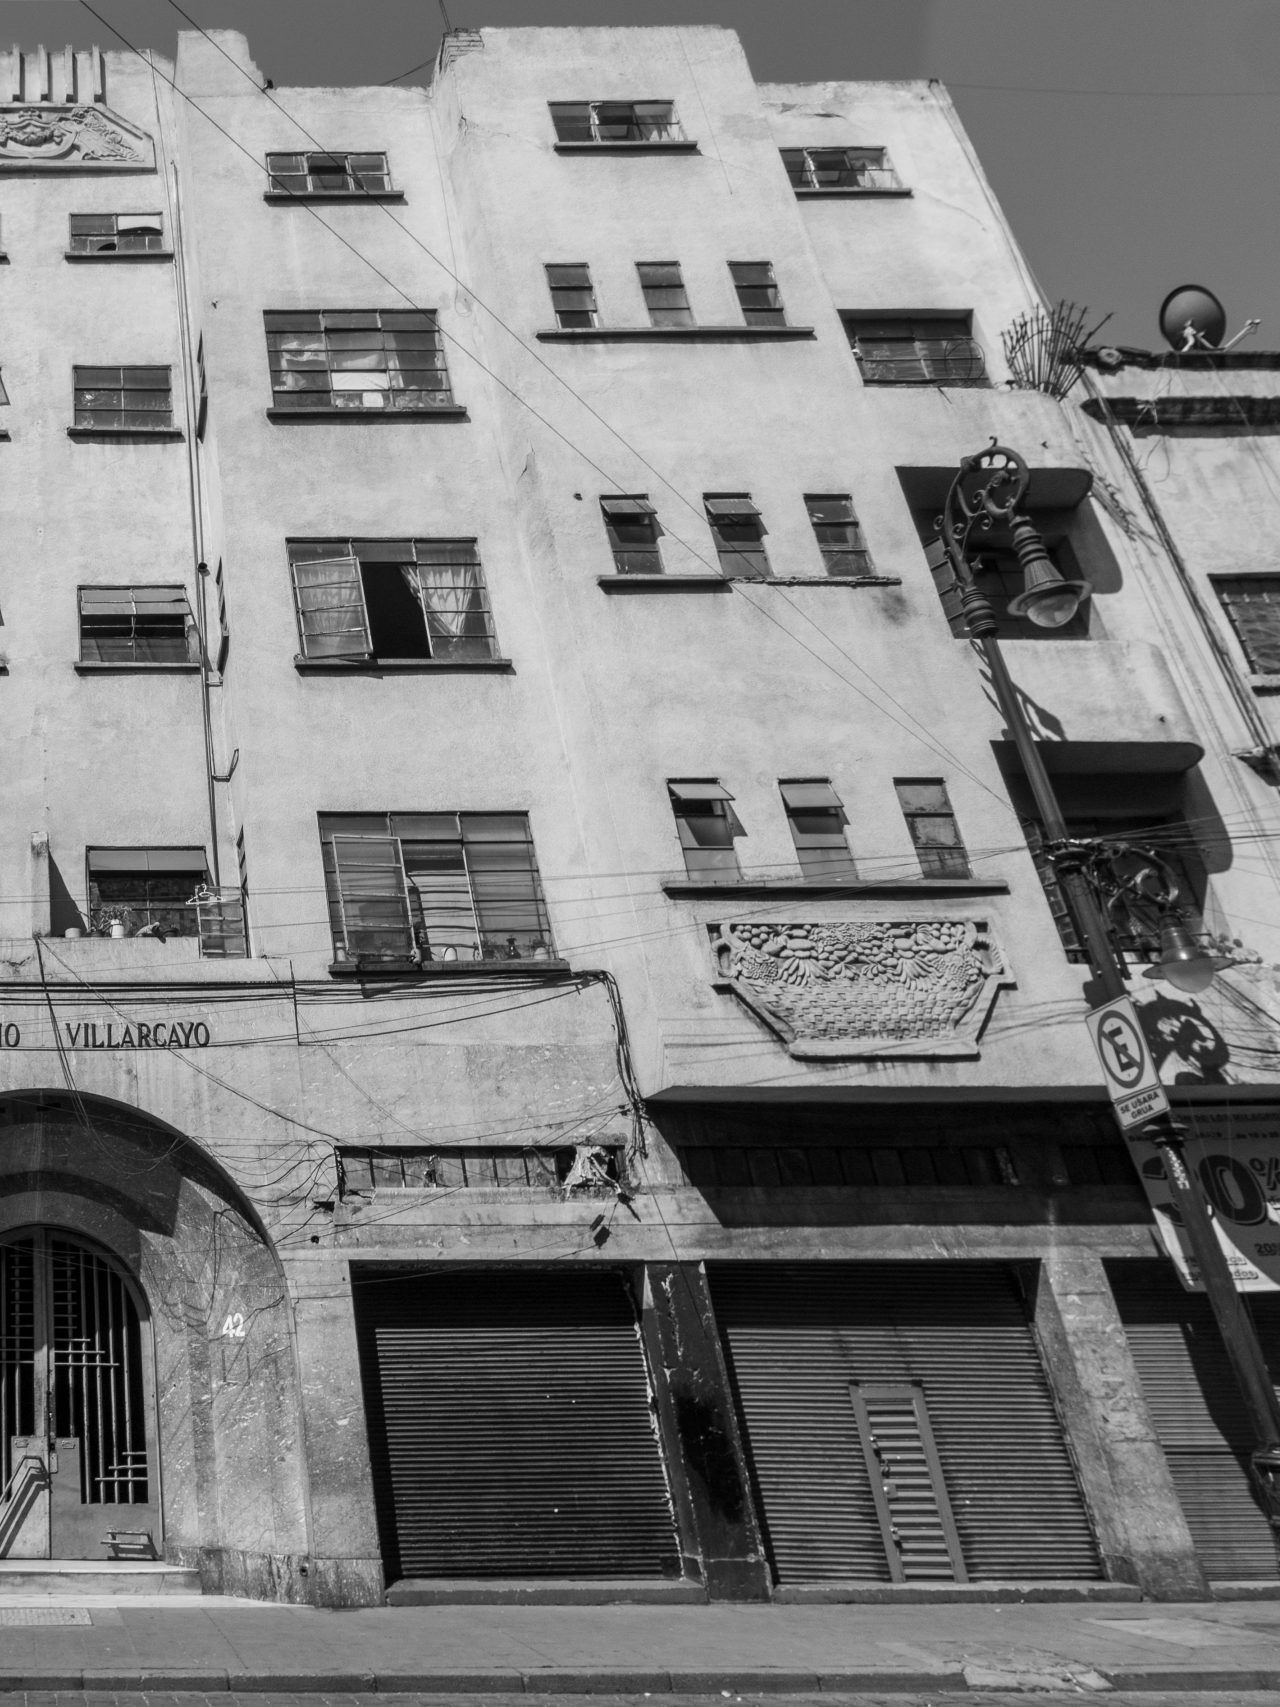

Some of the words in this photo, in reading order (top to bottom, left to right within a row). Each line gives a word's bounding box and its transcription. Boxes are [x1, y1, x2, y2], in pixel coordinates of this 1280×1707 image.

[65, 1022, 210, 1049] VILLARCAYO
[1120, 1101, 1131, 1115] SE
[1130, 1103, 1154, 1119] GRUA
[222, 1312, 245, 1338] 42
